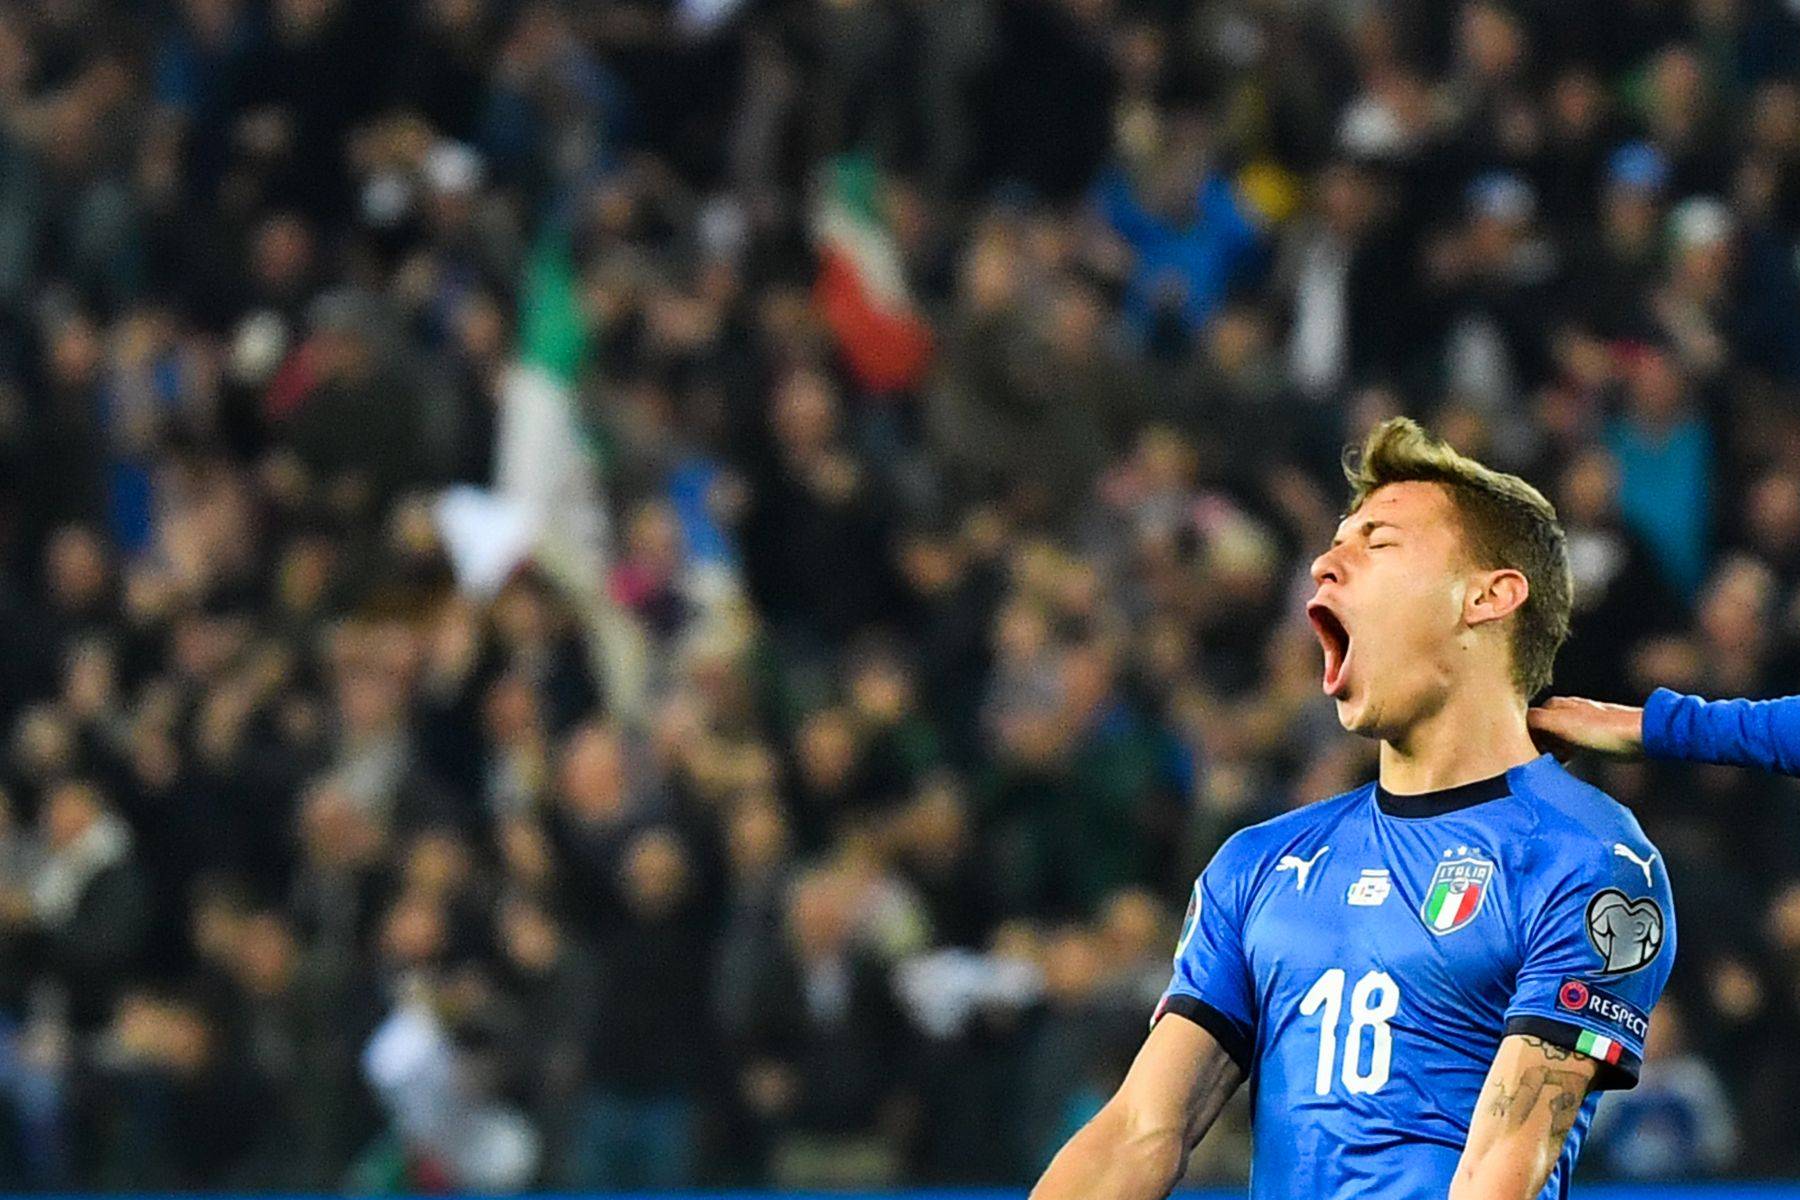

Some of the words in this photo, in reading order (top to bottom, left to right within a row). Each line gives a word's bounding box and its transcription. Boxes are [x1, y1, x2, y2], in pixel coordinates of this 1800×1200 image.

[1438, 865, 1488, 879] ITALIA
[1299, 968, 1400, 1095] 18
[1588, 994, 1648, 1038] RESPECT
